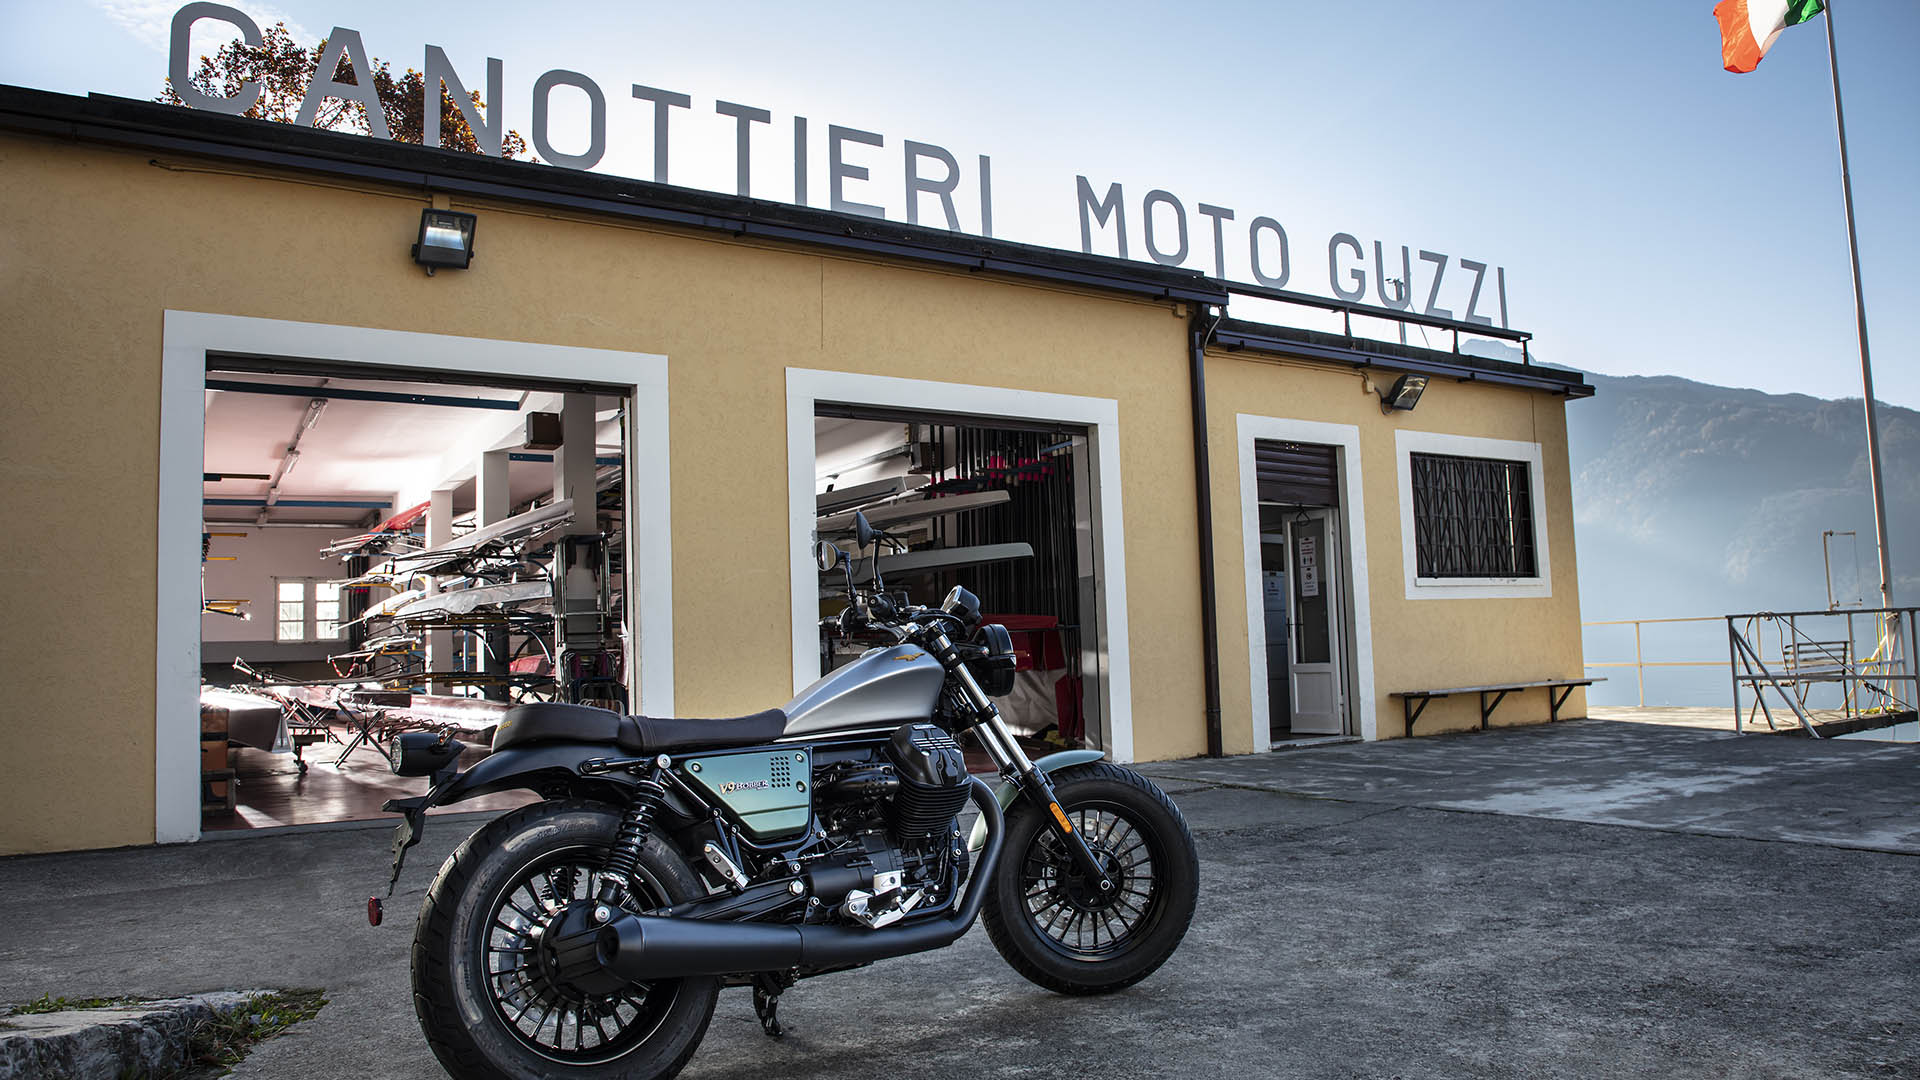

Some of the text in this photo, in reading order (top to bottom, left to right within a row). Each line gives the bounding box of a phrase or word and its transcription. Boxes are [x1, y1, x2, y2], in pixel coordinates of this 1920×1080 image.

[169, 1, 1508, 329] CANOTTIERI MOTO GUZZI
[718, 781, 736, 794] V9
